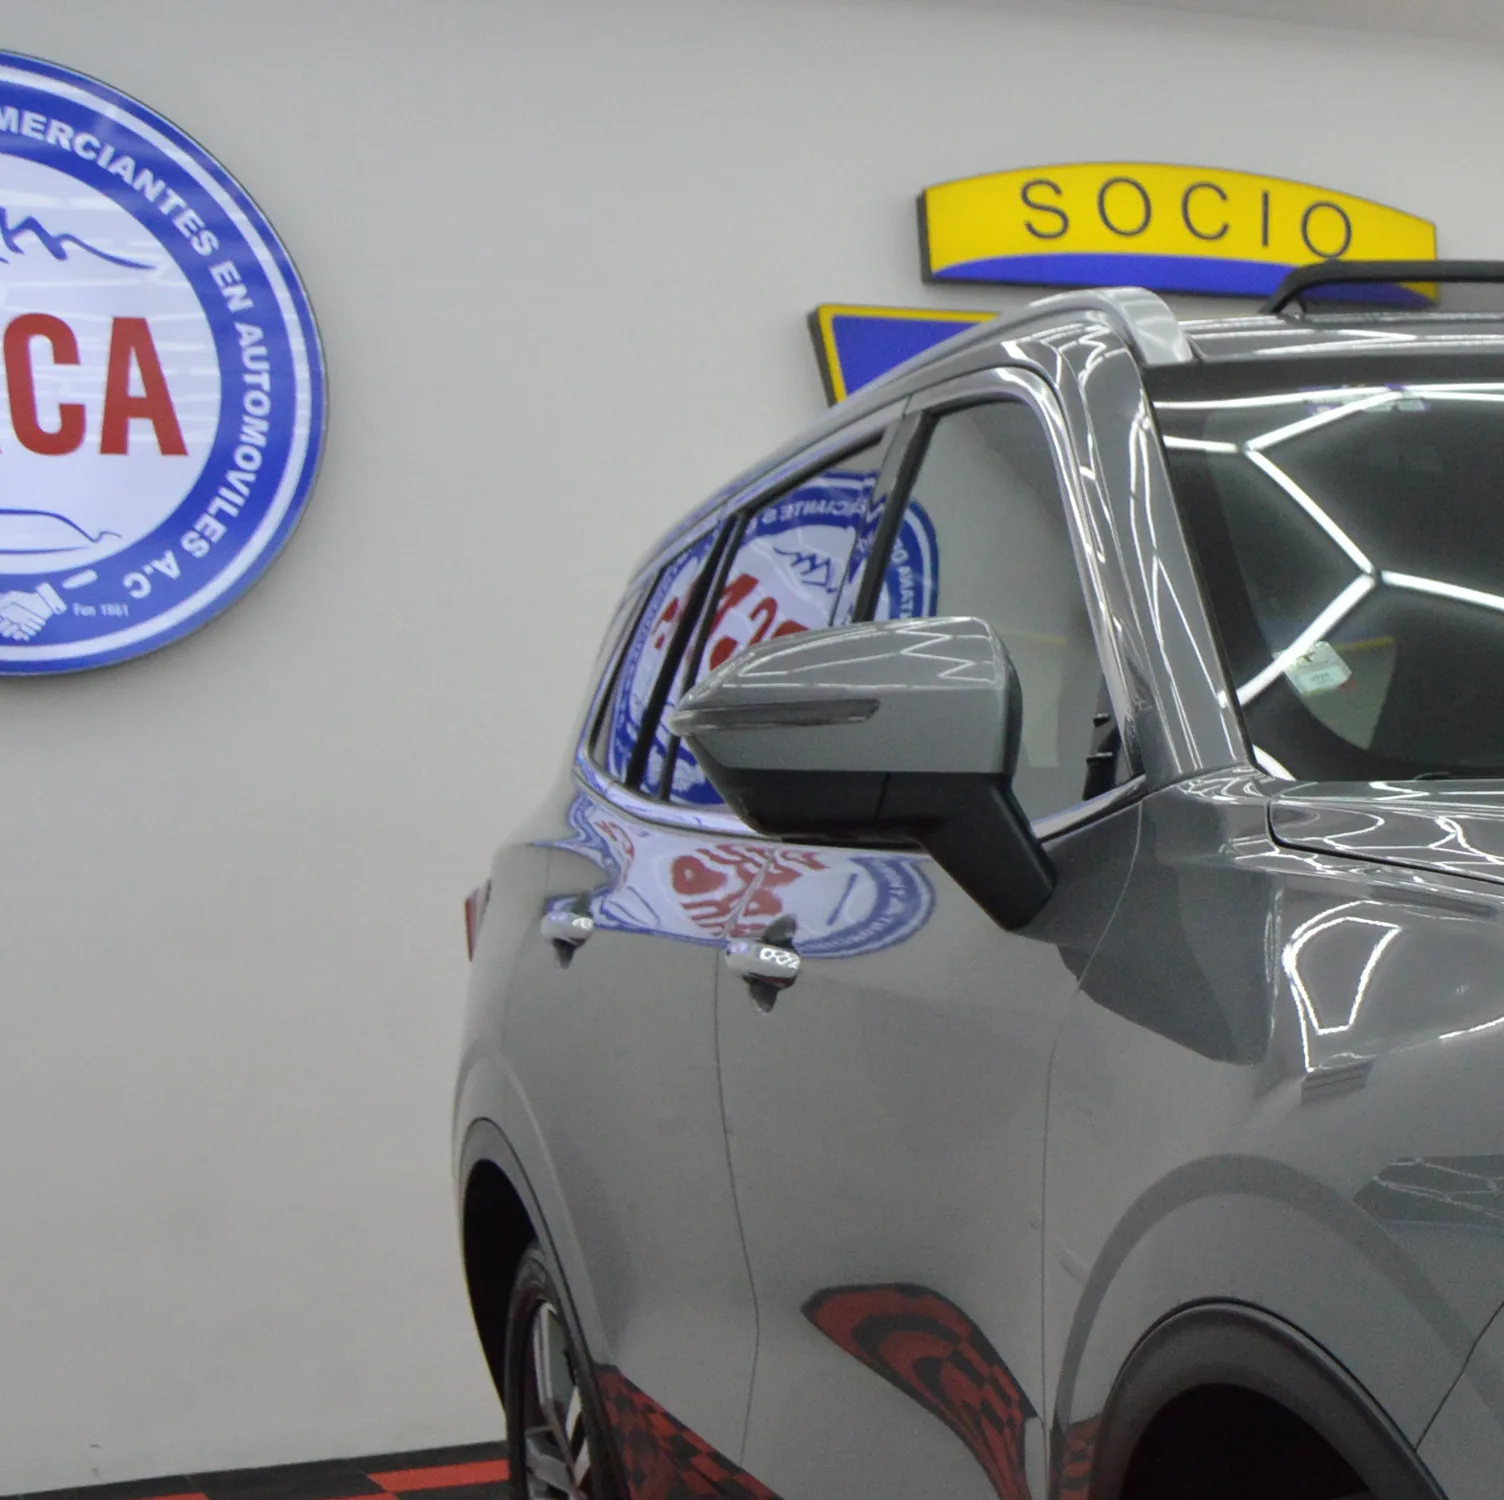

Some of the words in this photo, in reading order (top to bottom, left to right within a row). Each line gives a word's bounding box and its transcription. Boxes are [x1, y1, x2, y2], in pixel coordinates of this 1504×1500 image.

[1020, 176, 1353, 259] SOCIO
[210, 259, 254, 313] EN
[0, 312, 189, 456] CA
[181, 321, 272, 559] AUTOMOVILES
